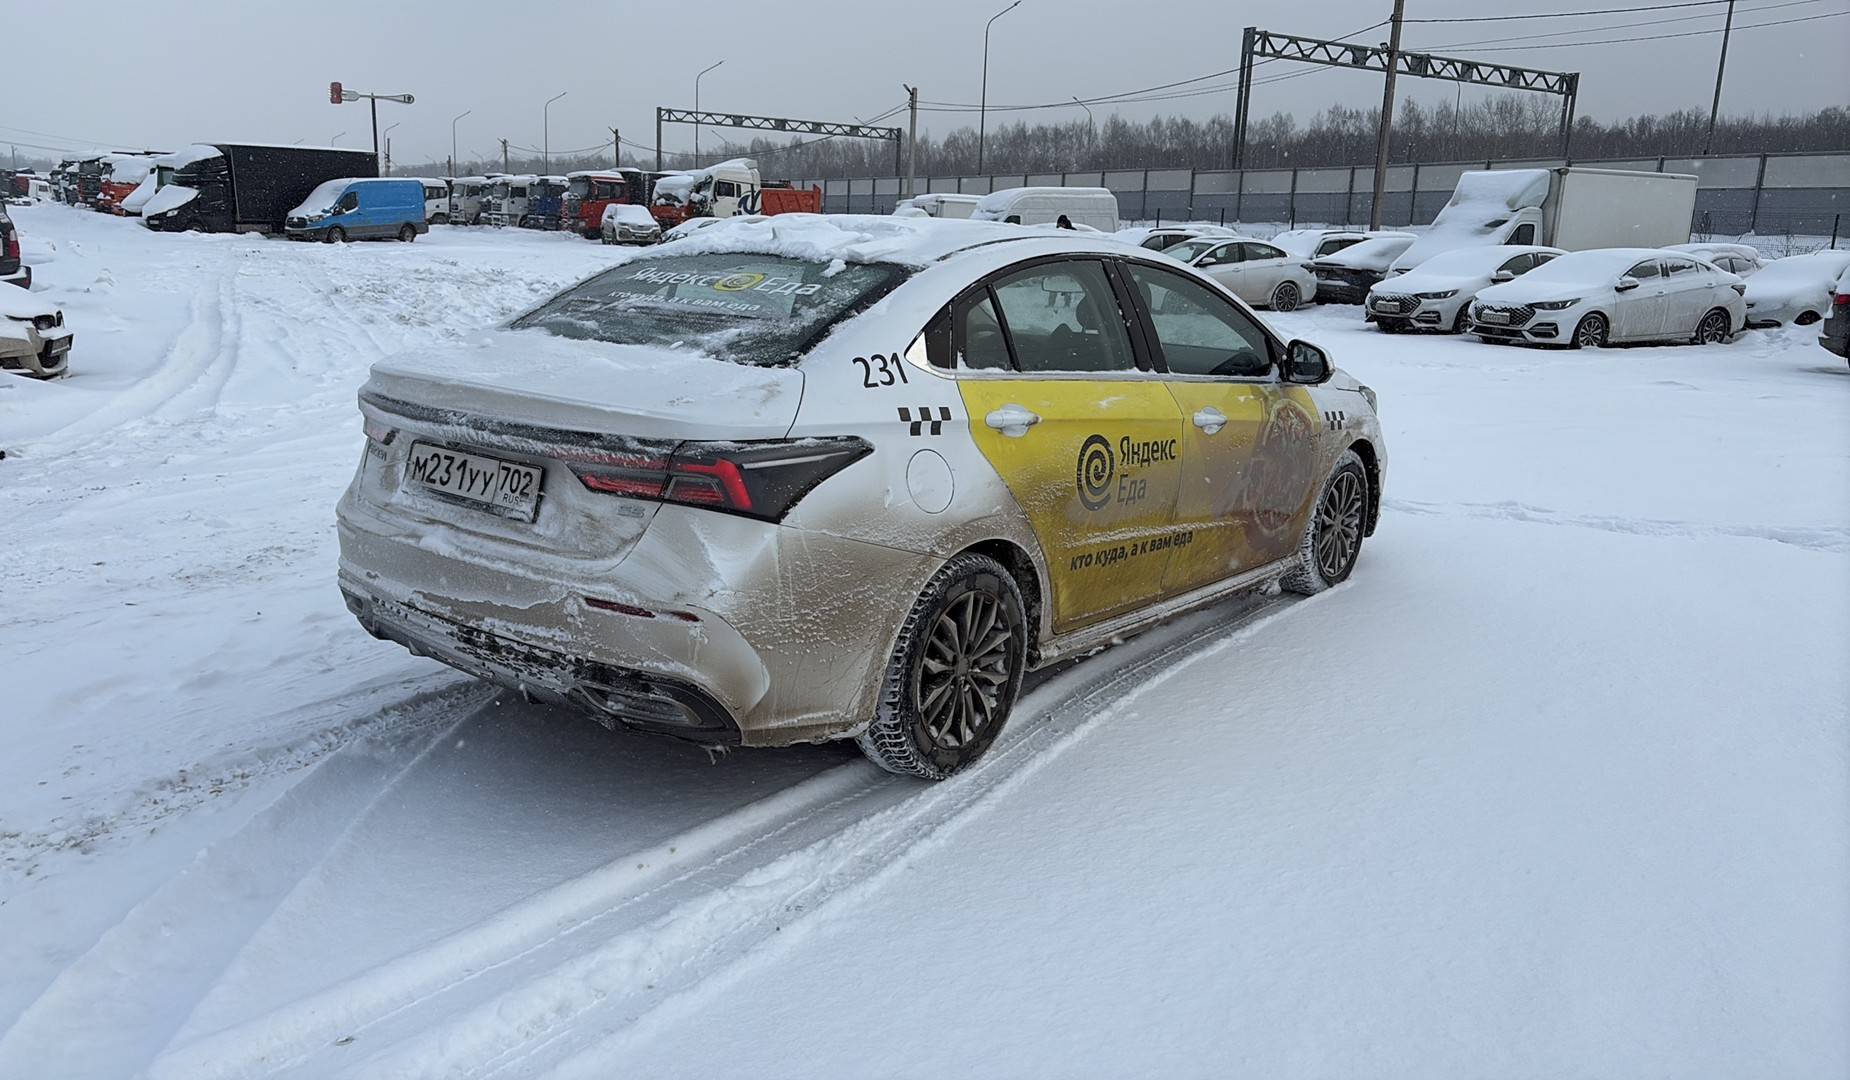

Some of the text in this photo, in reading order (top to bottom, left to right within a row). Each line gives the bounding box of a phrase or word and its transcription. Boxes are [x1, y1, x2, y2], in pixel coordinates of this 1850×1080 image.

[627, 267, 823, 297] Яндекс Еда
[727, 302, 762, 312] еда
[852, 352, 908, 388] 231
[1119, 435, 1177, 467] Яндекс
[500, 466, 533, 497] 702
[1117, 474, 1147, 506] Еда
[1070, 530, 1193, 571] кто куда, а к вам еда
